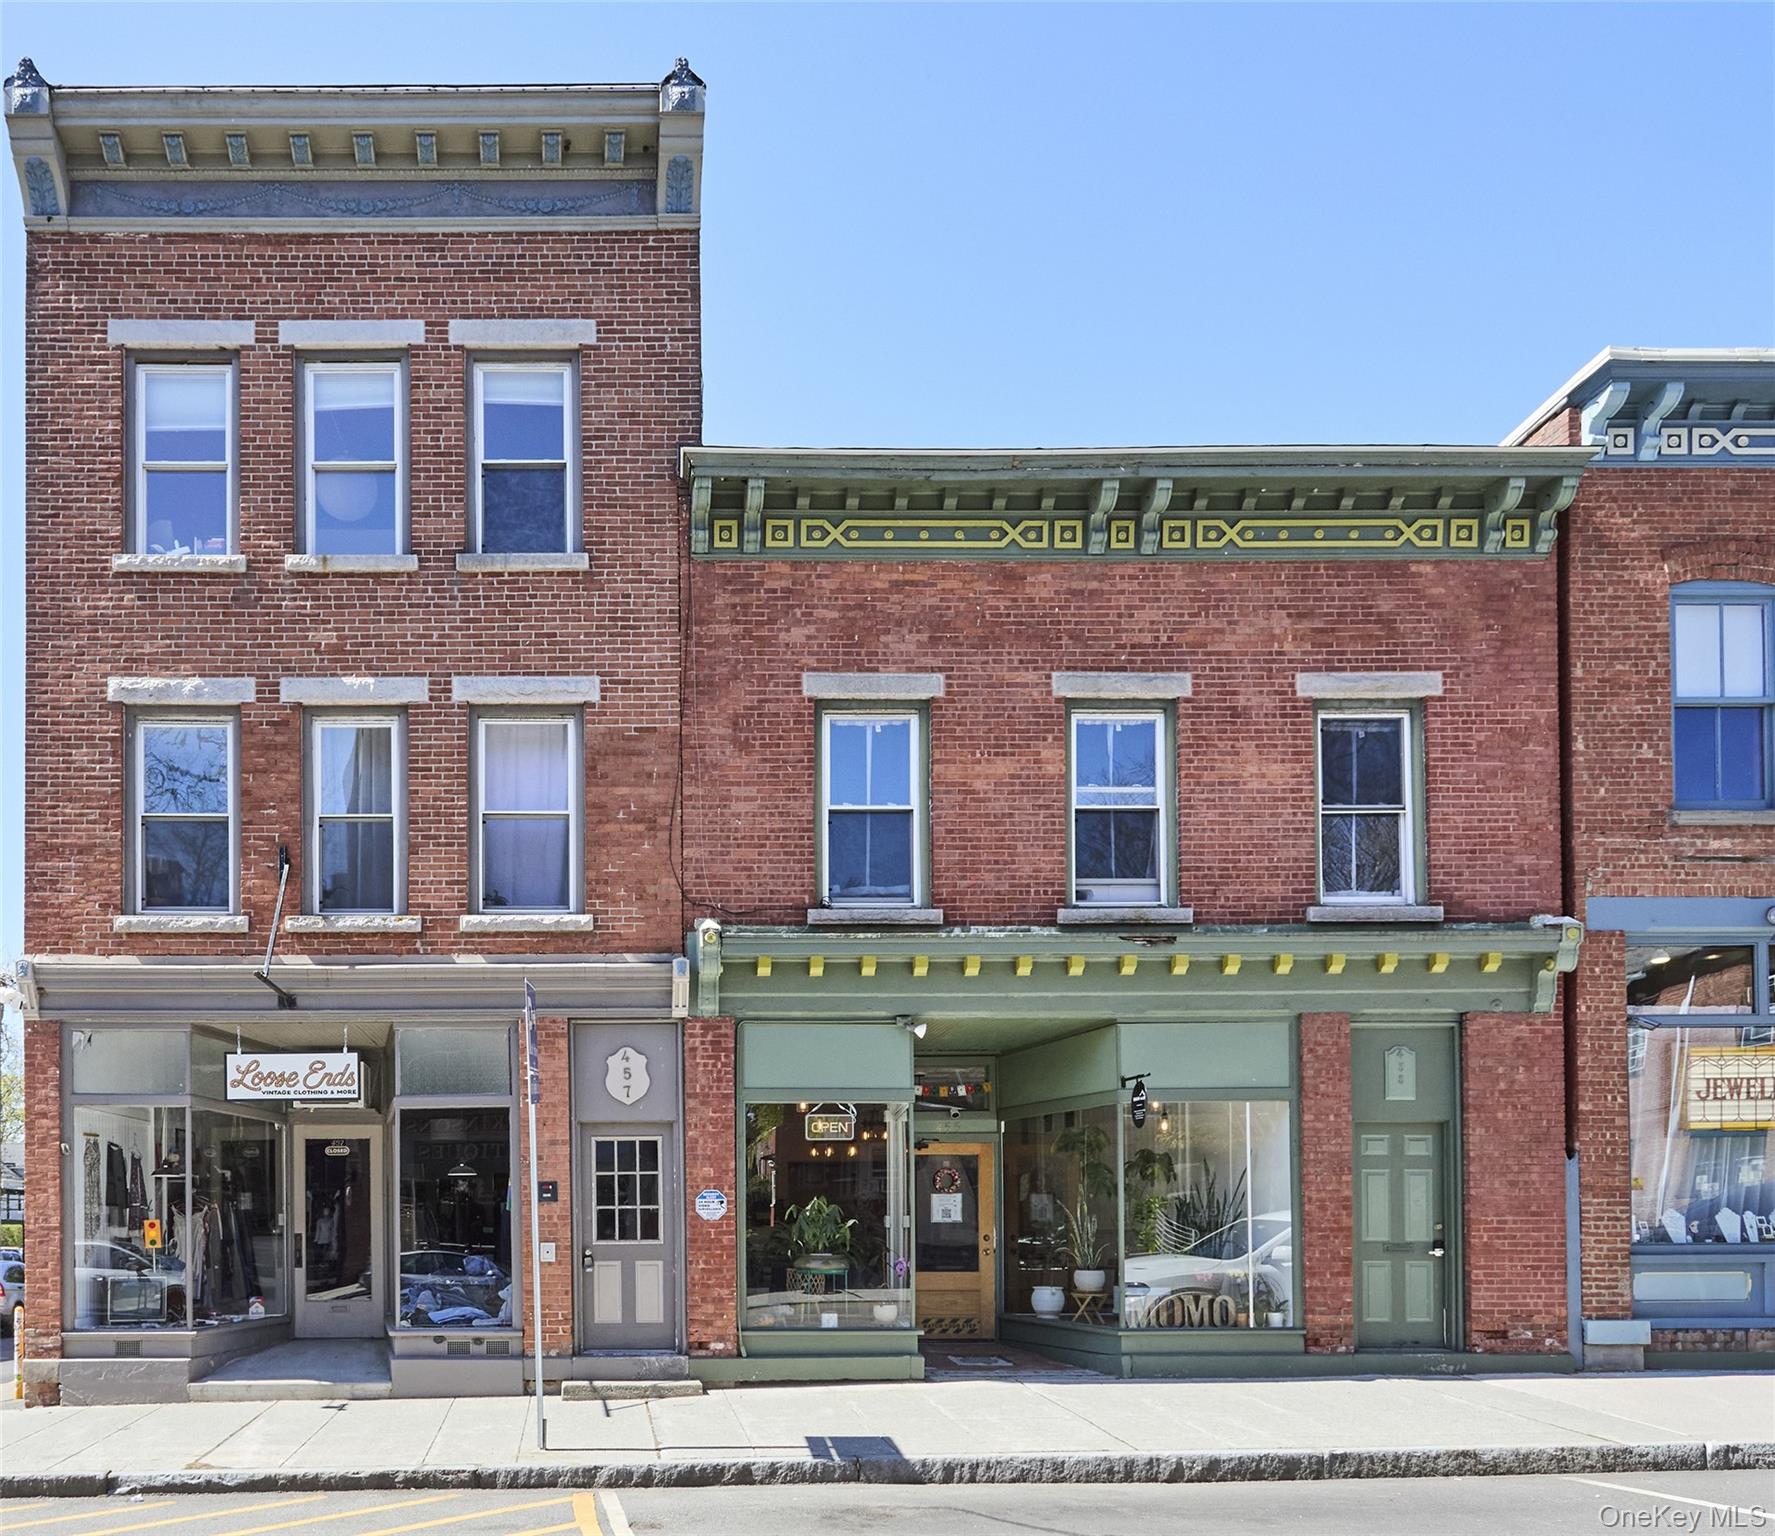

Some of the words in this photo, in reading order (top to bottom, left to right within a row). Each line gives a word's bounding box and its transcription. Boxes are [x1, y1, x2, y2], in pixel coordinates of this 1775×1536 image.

[229, 1059, 300, 1092] Loose
[302, 1059, 356, 1090] Ends
[621, 1050, 632, 1098] 457
[1695, 1077, 1775, 1101] JEWEL
[811, 1121, 849, 1133] OPEN
[1125, 1295, 1236, 1328] MOMO
